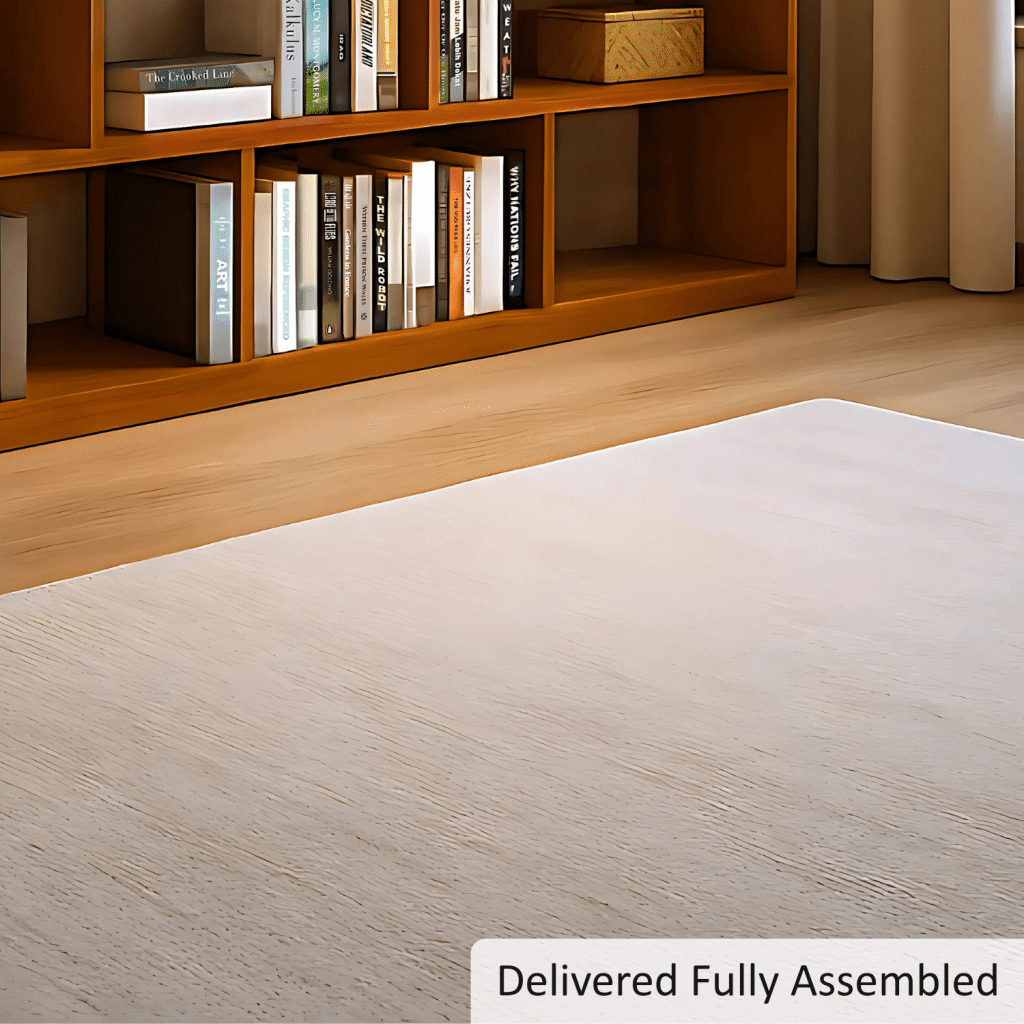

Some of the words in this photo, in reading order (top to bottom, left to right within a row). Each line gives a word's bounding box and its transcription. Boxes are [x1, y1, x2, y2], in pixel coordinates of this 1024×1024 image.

[145, 72, 166, 84] The
[168, 69, 209, 83] Crooked
[212, 67, 235, 80] Line
[509, 165, 520, 194] WHY
[324, 192, 337, 208] LORD
[376, 195, 385, 223] THE
[375, 227, 386, 264] WILD
[216, 258, 228, 289] ART
[509, 253, 520, 282] FAIL
[377, 266, 387, 312] ROBOT
